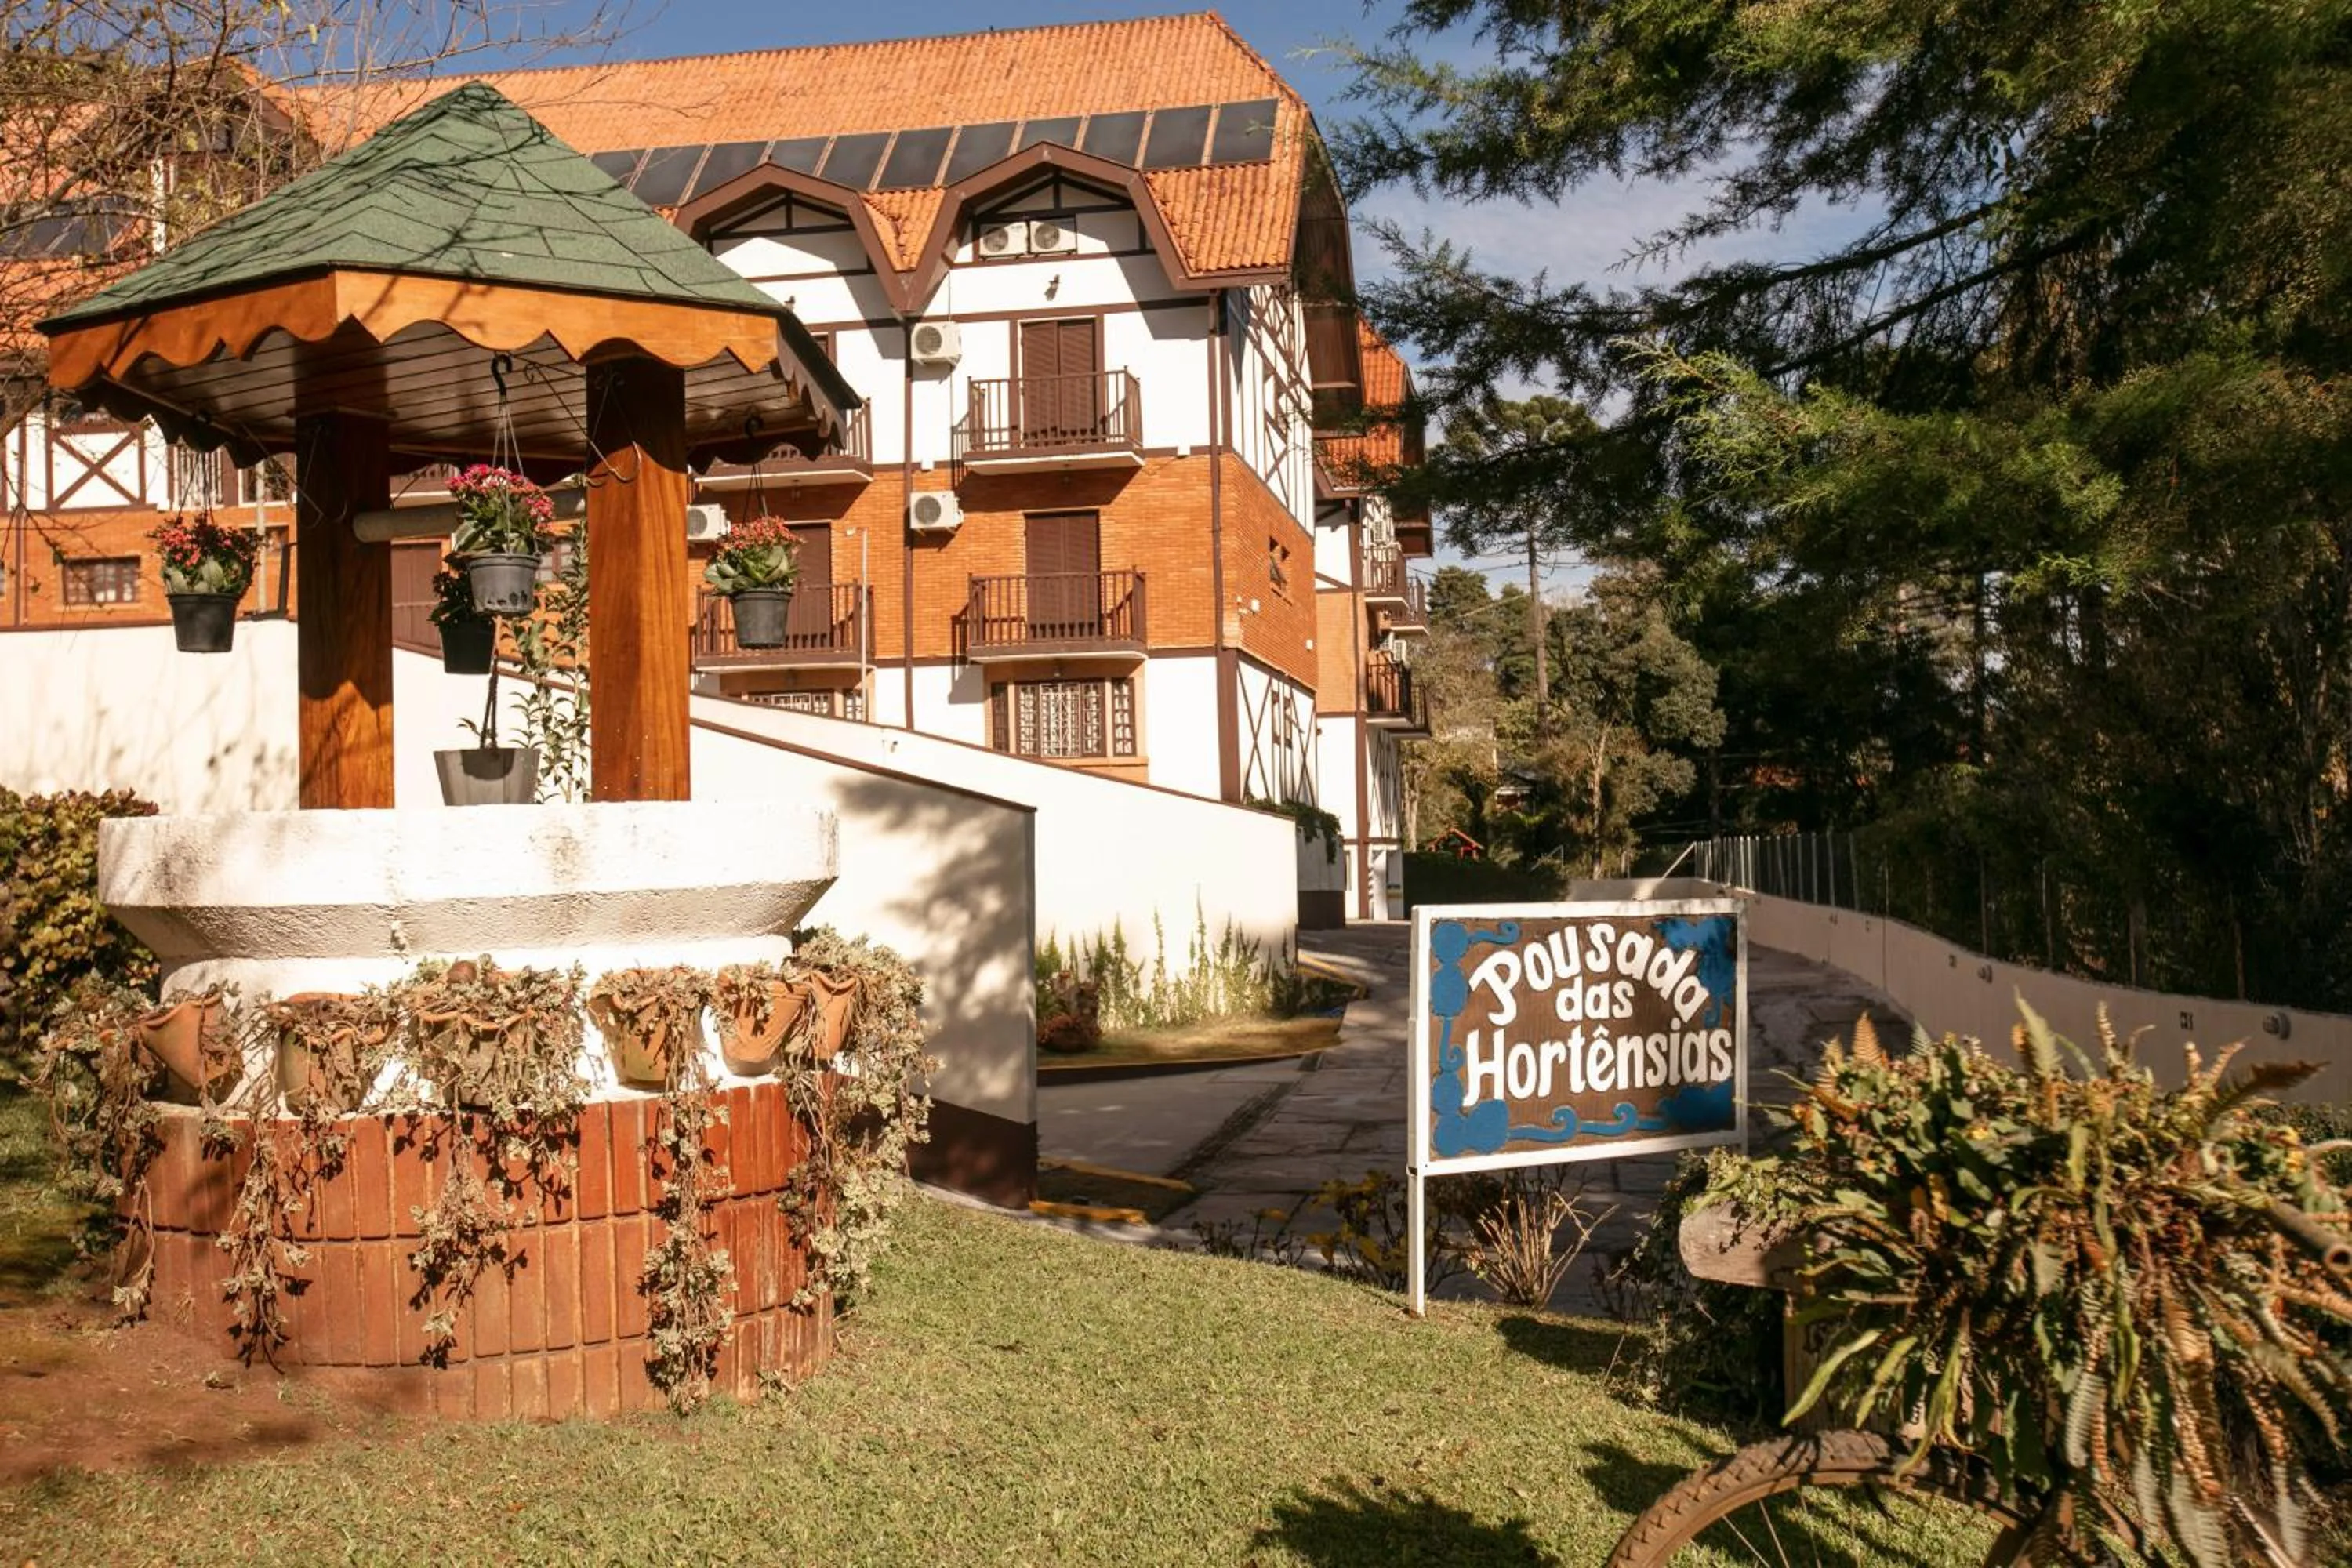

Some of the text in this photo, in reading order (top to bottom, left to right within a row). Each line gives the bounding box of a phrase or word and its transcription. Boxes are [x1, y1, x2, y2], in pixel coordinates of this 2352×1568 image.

[1468, 923, 1709, 1024] Pousada
[1555, 975, 1634, 1021] das
[1463, 1018, 1733, 1106] Hortênsias
